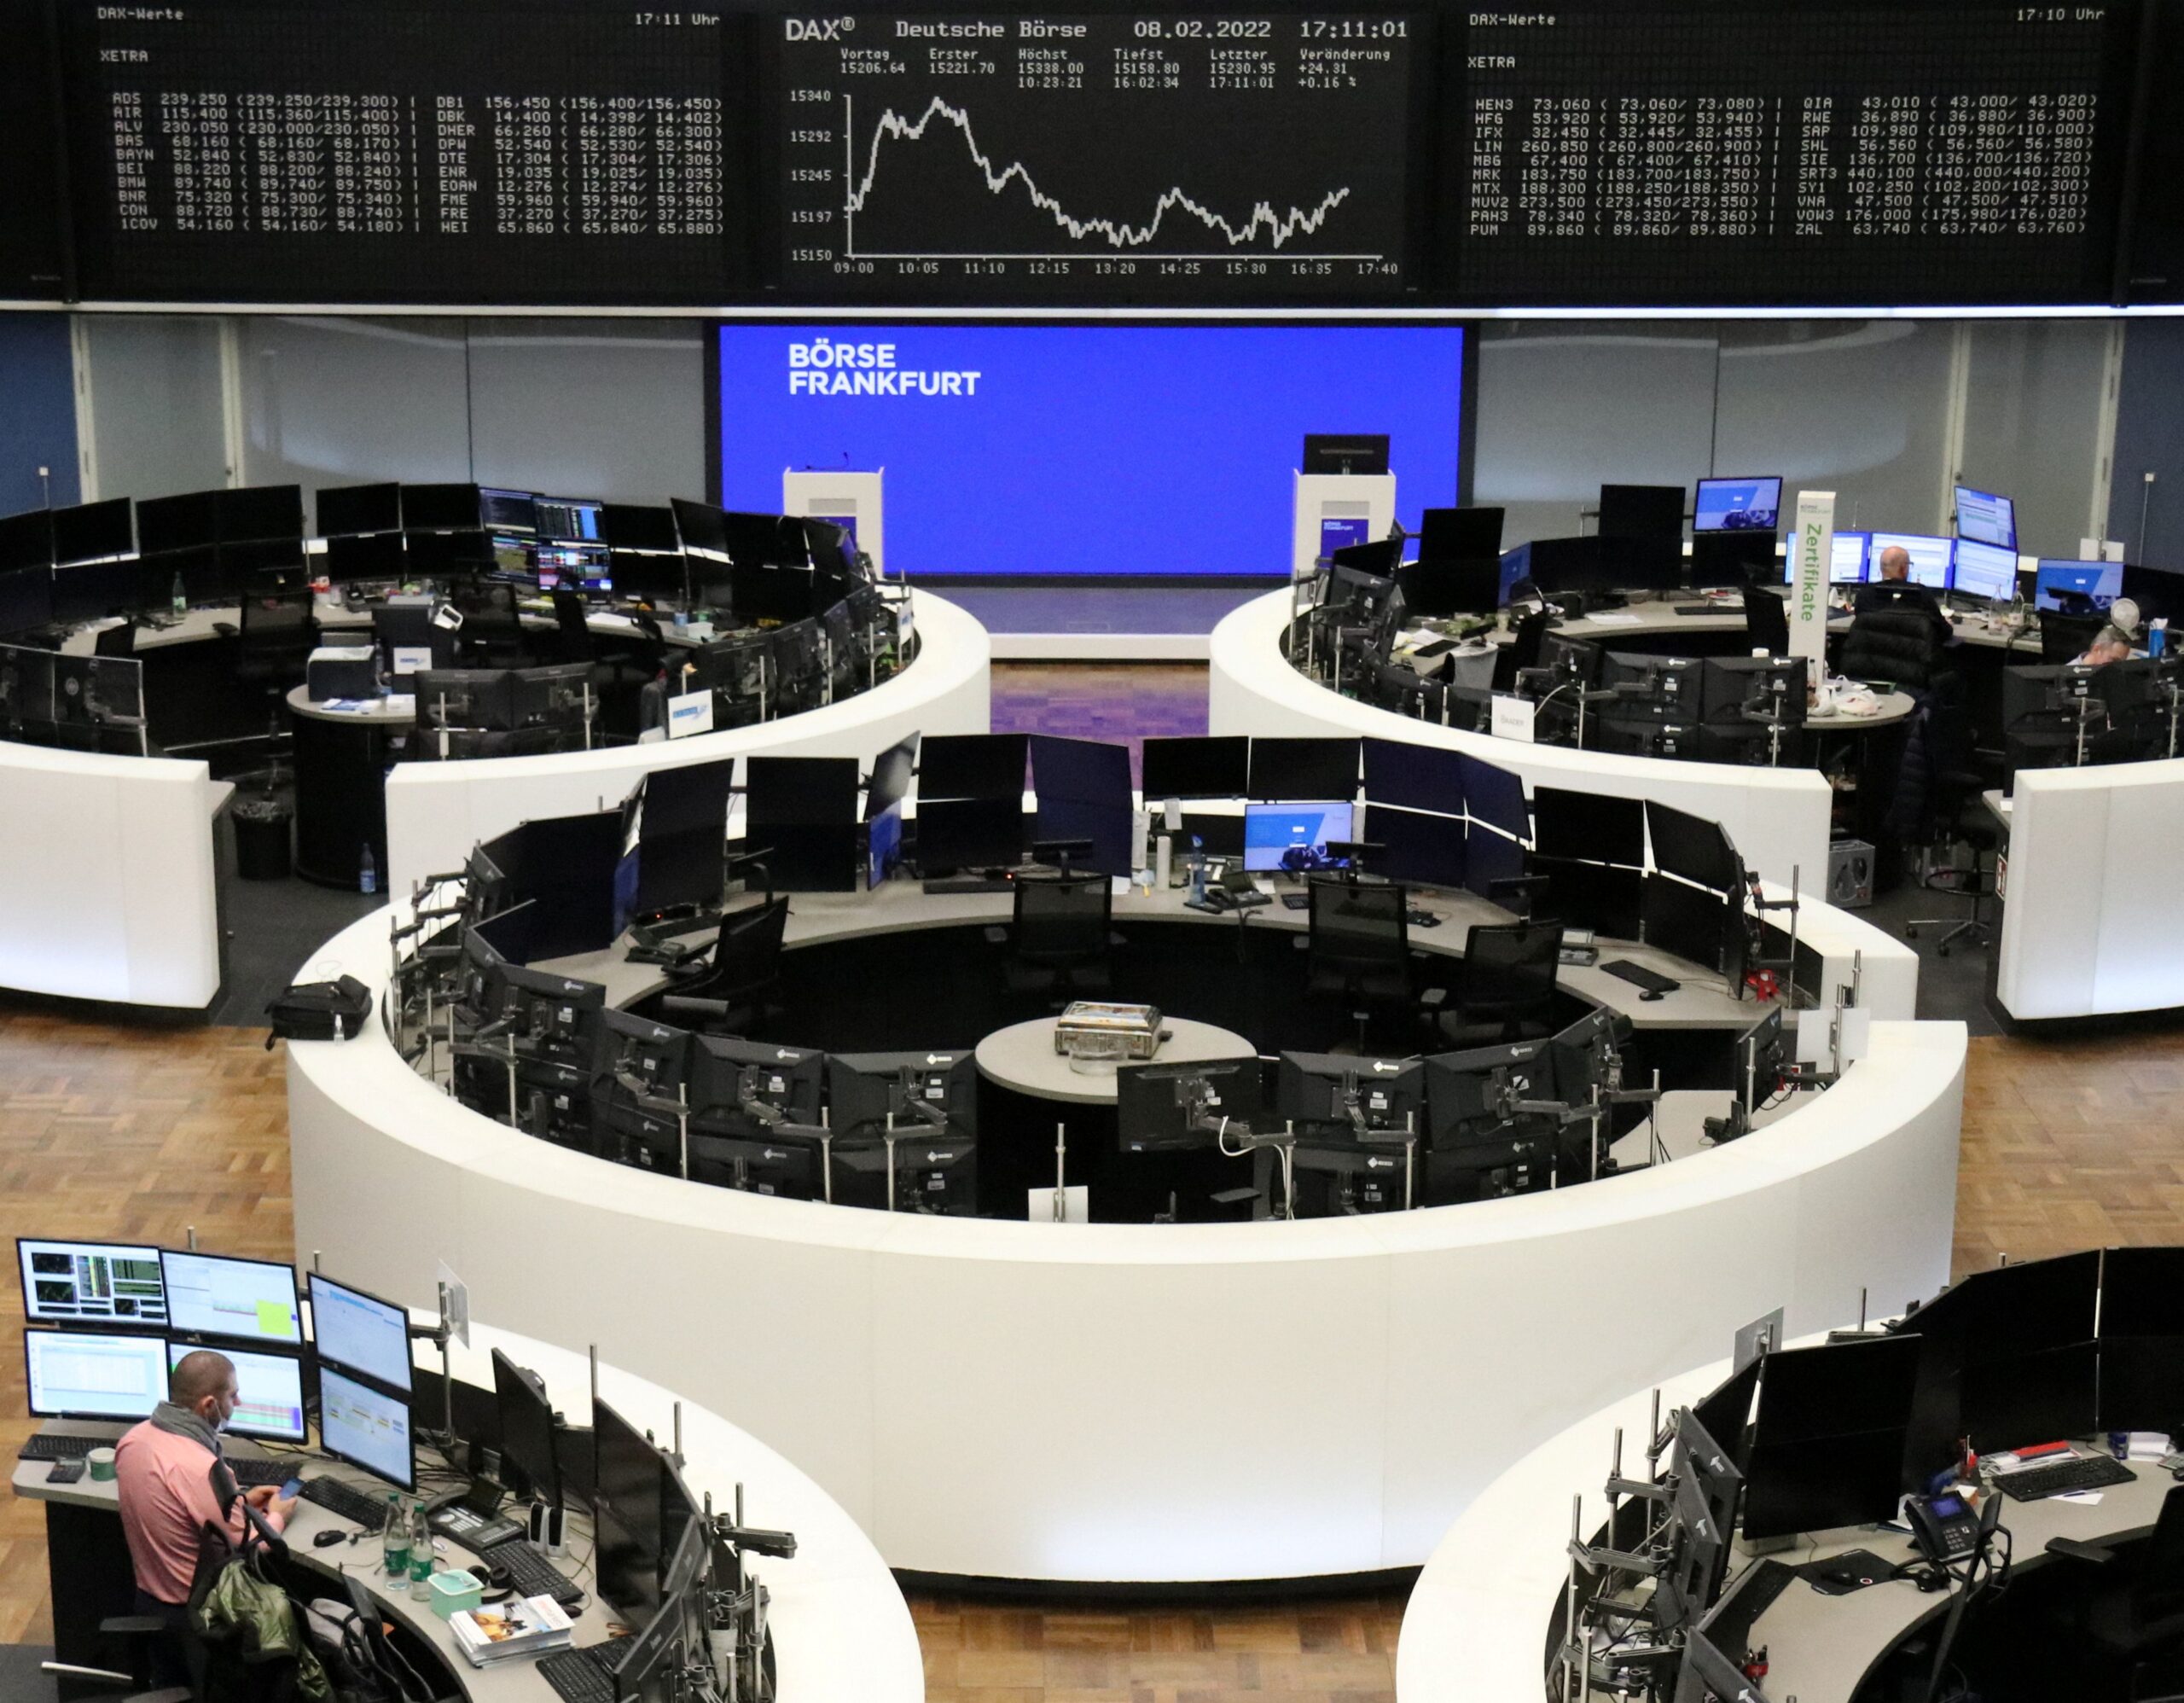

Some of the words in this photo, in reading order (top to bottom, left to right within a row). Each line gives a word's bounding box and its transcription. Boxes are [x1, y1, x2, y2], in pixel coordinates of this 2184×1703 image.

[97, 7, 184, 20] DAX-Werte
[636, 13, 681, 25] 17:11
[692, 13, 720, 25] Uhr
[2018, 9, 2065, 20] 17:10
[2076, 9, 2105, 20] Uhr
[1469, 14, 1556, 26] DAX-Werte
[896, 21, 1004, 37] Deutsche
[1019, 20, 1086, 37] Börse
[1135, 21, 1270, 38] 08.02.2022
[1301, 21, 1406, 38] 17:11:01
[101, 50, 148, 61] XETRA
[841, 49, 889, 61] Vortag
[930, 48, 978, 60] Erster
[1019, 49, 1067, 60] Höchst
[1114, 49, 1163, 60] Tiefst
[1211, 49, 1267, 60] Letzter
[1300, 49, 1390, 61] Veränderung
[841, 62, 905, 73] 15206.64
[930, 62, 995, 73] 15221.70
[1019, 62, 1083, 73] 15338.00
[1115, 62, 1179, 73] 15158.80
[1211, 62, 1275, 74] 15230.95
[1299, 62, 1346, 74] +24.31
[1467, 56, 1516, 68] XETRA
[1019, 77, 1082, 88] 10:23:21
[1114, 77, 1179, 88] 16:02:34
[1211, 77, 1273, 88] 17:11:01
[1298, 77, 1339, 88] +0.16
[113, 93, 141, 104] ADS
[161, 93, 226, 105] 239,250
[437, 96, 463, 108] DB1
[486, 96, 550, 108] 156,450
[791, 90, 831, 102] 15340
[1804, 97, 1832, 108] QIA
[1862, 96, 1920, 108] 43,010
[1476, 99, 1513, 110] HEN3
[1534, 98, 1589, 110] 73,060
[113, 107, 142, 118] AIR
[163, 108, 227, 119] 115,400
[438, 110, 464, 122] DBK
[497, 111, 550, 123] 14,400
[1476, 113, 1502, 124] HFG
[1533, 113, 1589, 124] 53,920
[1804, 112, 1831, 123] RWE
[1862, 111, 1919, 123] 36,890
[114, 121, 142, 132] ALV
[163, 121, 228, 133] 230,050
[438, 125, 474, 136] DHER
[495, 125, 550, 137] 66,260
[1477, 127, 1502, 138] IFX
[1533, 127, 1589, 138] 32,450
[1803, 125, 1830, 137] SAP
[1852, 125, 1917, 137] 109,980
[115, 135, 143, 146] BAS
[172, 136, 229, 147] 68,160
[792, 131, 831, 142] 15292
[439, 138, 466, 149] DPW
[495, 138, 551, 150] 52,540
[1474, 141, 1502, 152] LIN
[1522, 141, 1588, 152] 260,850
[1802, 140, 1828, 151] SHL
[1860, 139, 1916, 150] 56,560
[116, 148, 154, 160] BAYN
[173, 149, 229, 160] 52,840
[439, 152, 466, 164] DTE
[497, 153, 551, 164] 17,304
[1800, 154, 1827, 165] SIE
[1850, 153, 1915, 165] 136,700
[1474, 155, 1501, 166] MBG
[1531, 155, 1587, 166] 67,400
[117, 162, 143, 174] BEI
[174, 163, 230, 175] 88,220
[439, 166, 467, 177] ENR
[498, 167, 552, 178] 19,035
[1473, 169, 1500, 179] MRK
[1522, 169, 1587, 180] 183,750
[1799, 168, 1837, 179] SRT3
[1848, 167, 1914, 178] 440,100
[792, 170, 831, 181] 15245
[119, 177, 146, 188] BMW
[175, 177, 231, 189] 89,740
[440, 180, 477, 191] EOAN
[498, 181, 552, 192] 12,276
[1472, 183, 1500, 194] MTX
[1522, 183, 1586, 194] 188,300
[1798, 182, 1824, 193] SY1
[1848, 181, 1913, 193] 102,250
[119, 190, 146, 201] BNR
[176, 191, 231, 202] 75,320
[440, 194, 468, 205] FME
[497, 195, 553, 206] 59,960
[1472, 197, 1508, 207] MUV2
[1519, 196, 1585, 207] 273,500
[1798, 196, 1825, 206] VNA
[1856, 195, 1912, 206] 47,500
[119, 204, 148, 215] CON
[177, 205, 232, 217] 88,720
[441, 207, 468, 218] FRE
[498, 208, 553, 219] 37,270
[793, 211, 831, 222] 15197
[1472, 211, 1508, 221] PAH3
[1529, 211, 1584, 222] 78,340
[1797, 209, 1833, 220] VOW3
[1846, 209, 1911, 220] 176,000
[122, 218, 157, 230] 1COV
[177, 218, 233, 230] 54,160
[441, 222, 467, 232] HEI
[498, 222, 554, 233] 65,860
[1471, 224, 1498, 235] PUM
[1528, 224, 1583, 235] 89,860
[1796, 224, 1822, 235] ZAL
[1854, 223, 1910, 235] 63,740
[793, 250, 832, 260] 15150
[834, 262, 874, 273] 09:00
[899, 262, 938, 273] 10:05
[966, 263, 1004, 273] 11:10
[1031, 263, 1069, 274] 12:15
[1096, 263, 1136, 274] 13:20
[1161, 263, 1200, 274] 14:25
[1227, 263, 1266, 274] 15:30
[1292, 263, 1331, 274] 16:35
[1358, 264, 1397, 274] 17:40
[789, 338, 897, 369] BÖRSE
[789, 371, 981, 396] FRANKFURT
[1801, 523, 1822, 621] Zertifikate
